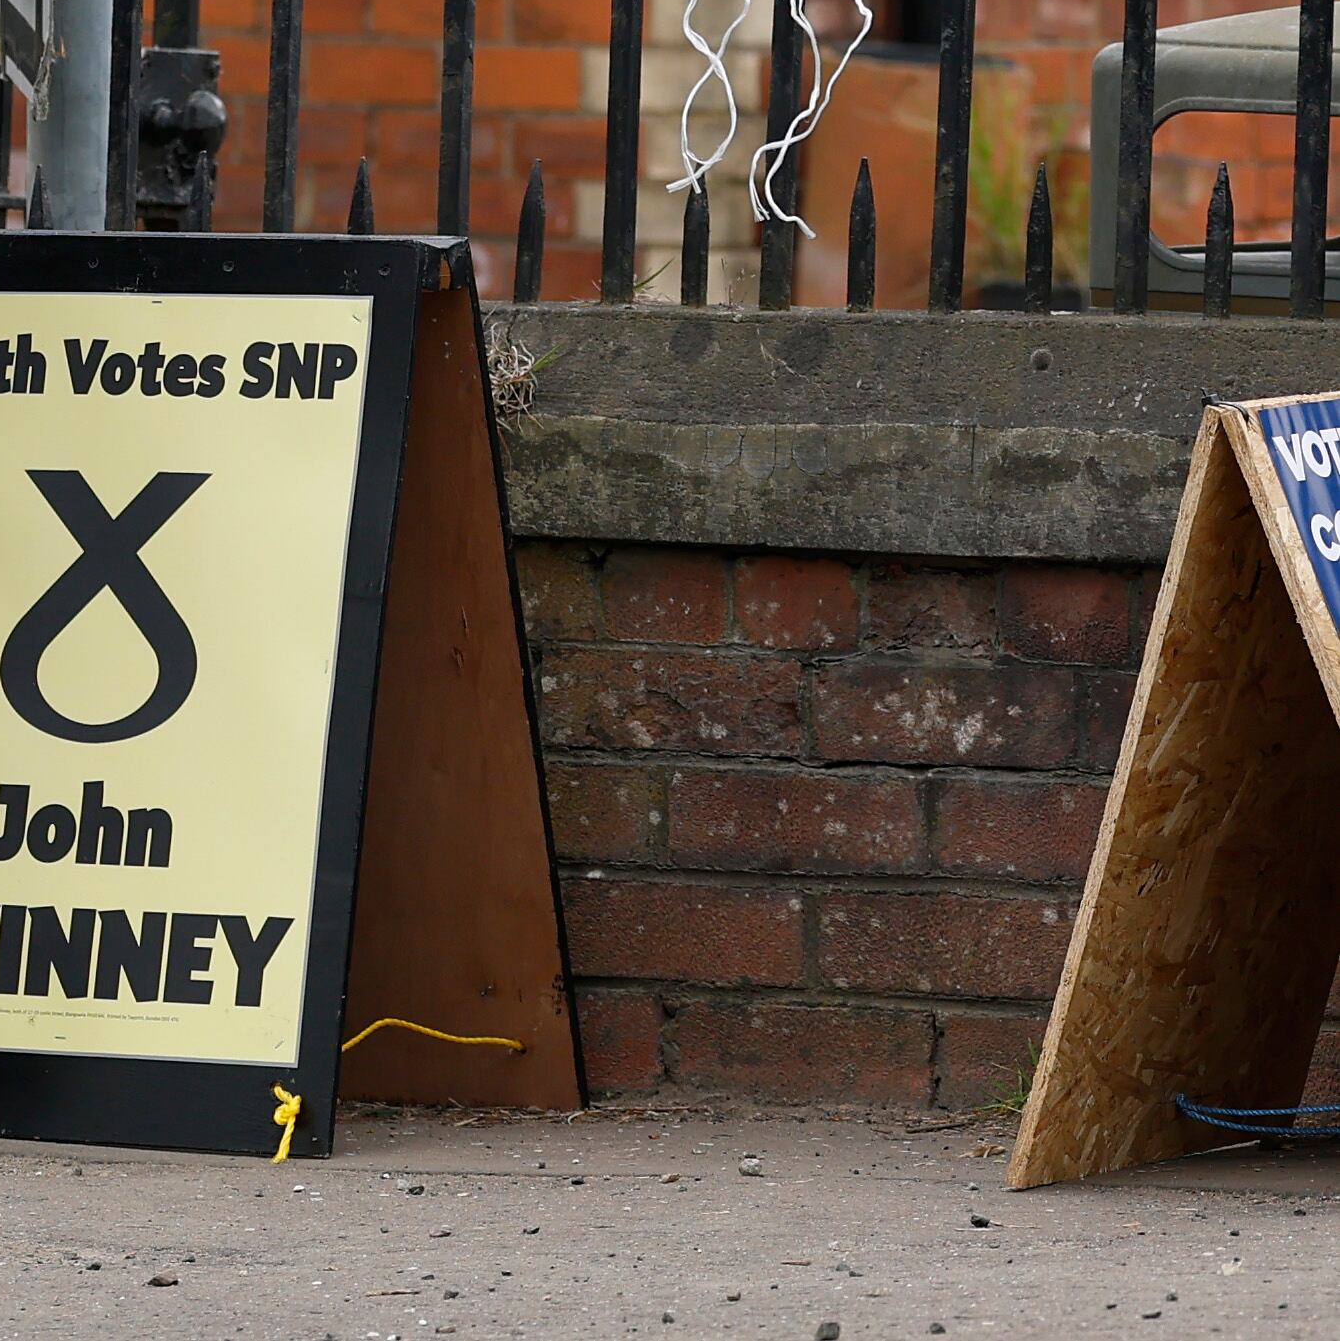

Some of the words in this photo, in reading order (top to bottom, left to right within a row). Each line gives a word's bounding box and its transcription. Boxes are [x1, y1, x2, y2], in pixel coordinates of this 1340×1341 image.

[64, 339, 227, 398] Votes
[239, 342, 358, 400] SNP
[1272, 427, 1340, 482] VOT
